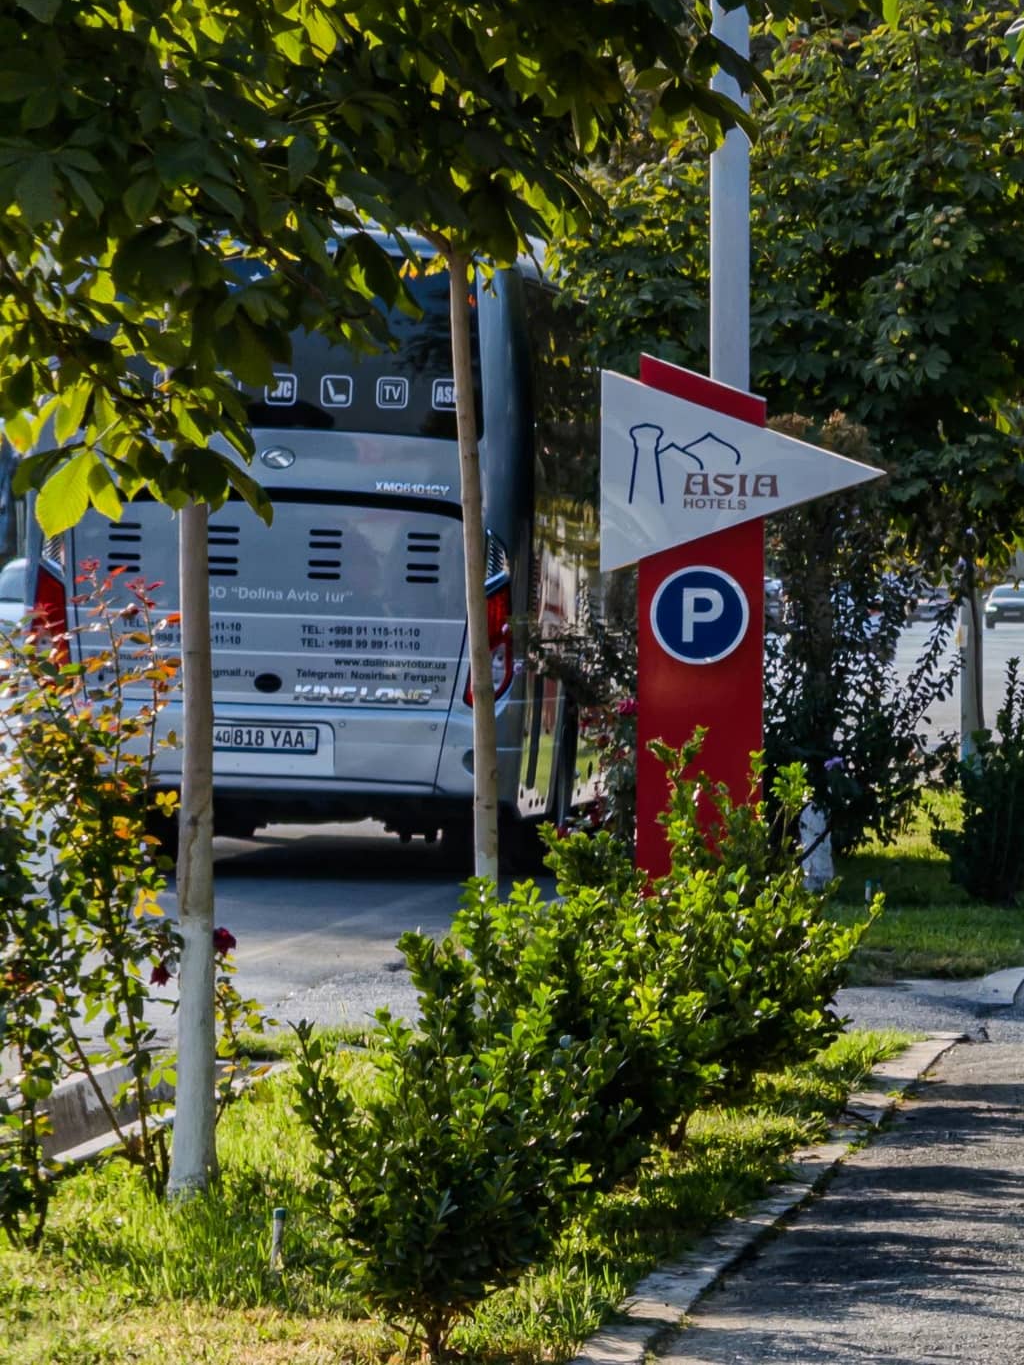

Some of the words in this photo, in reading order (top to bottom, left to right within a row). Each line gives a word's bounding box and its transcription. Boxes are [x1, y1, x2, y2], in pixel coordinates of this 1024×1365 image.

[384, 385, 401, 401] TV
[683, 473, 779, 497] ASIA
[683, 498, 747, 510] HOTELS
[286, 589, 319, 602] Avto
[682, 587, 724, 643] P
[301, 625, 324, 635] TEL:
[328, 626, 353, 636] +998
[300, 638, 324, 648] TEL:
[328, 639, 351, 649] +998
[234, 729, 265, 747] 818
[270, 730, 305, 747] YAA
